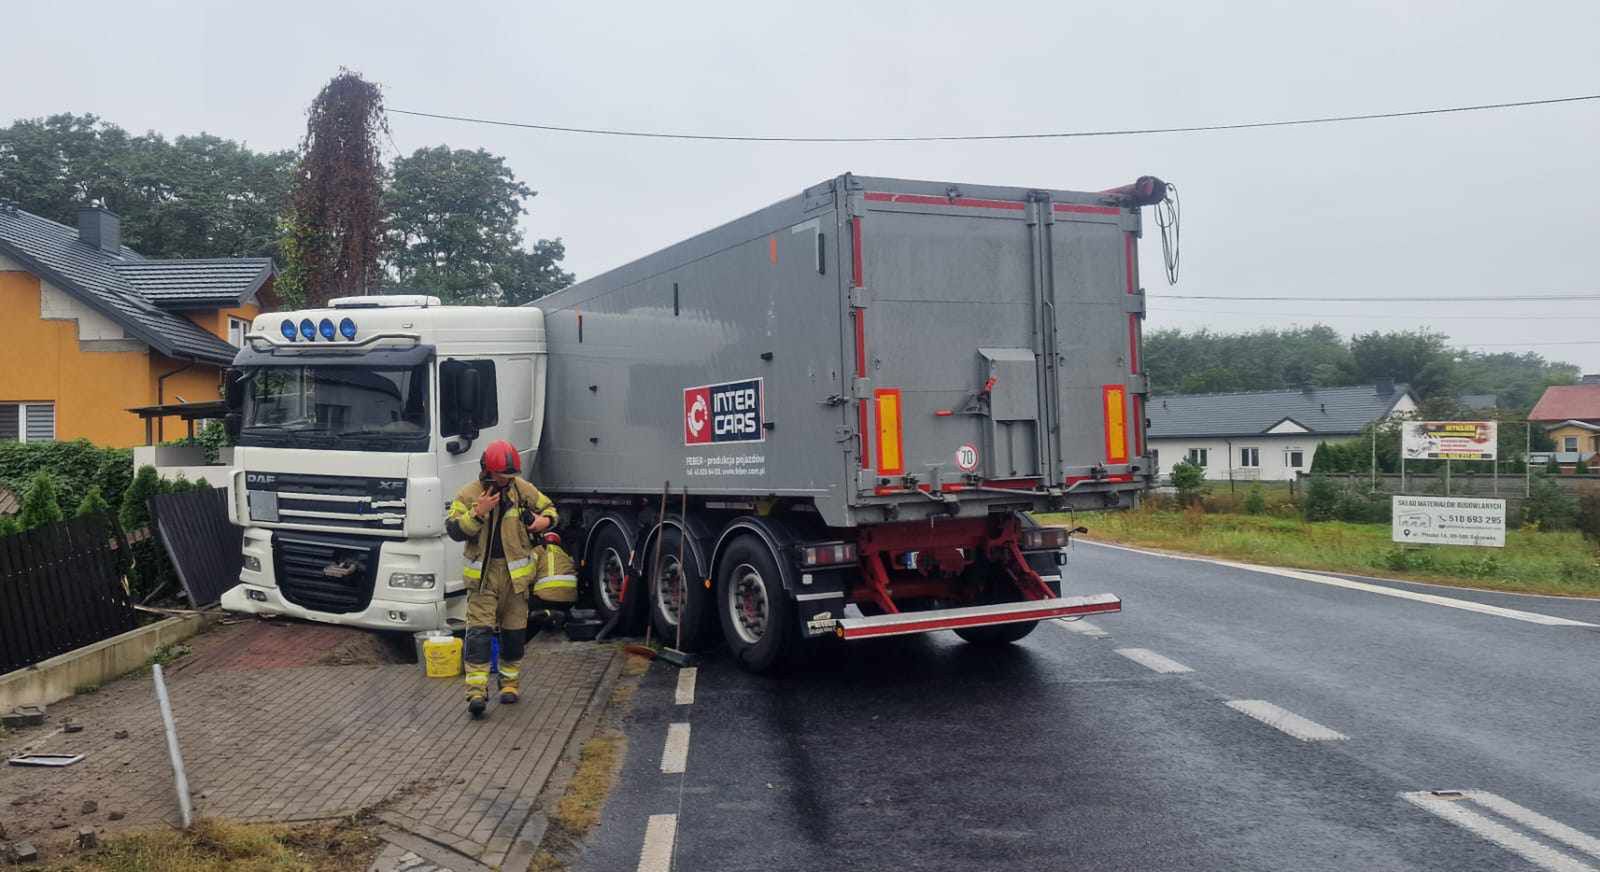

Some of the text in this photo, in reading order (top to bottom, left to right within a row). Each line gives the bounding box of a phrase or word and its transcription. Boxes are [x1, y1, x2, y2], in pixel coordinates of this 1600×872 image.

[714, 389, 755, 412] INTER
[714, 413, 756, 434] CARS
[961, 450, 973, 465] 70
[247, 474, 276, 483] DAF
[379, 481, 405, 489] XF
